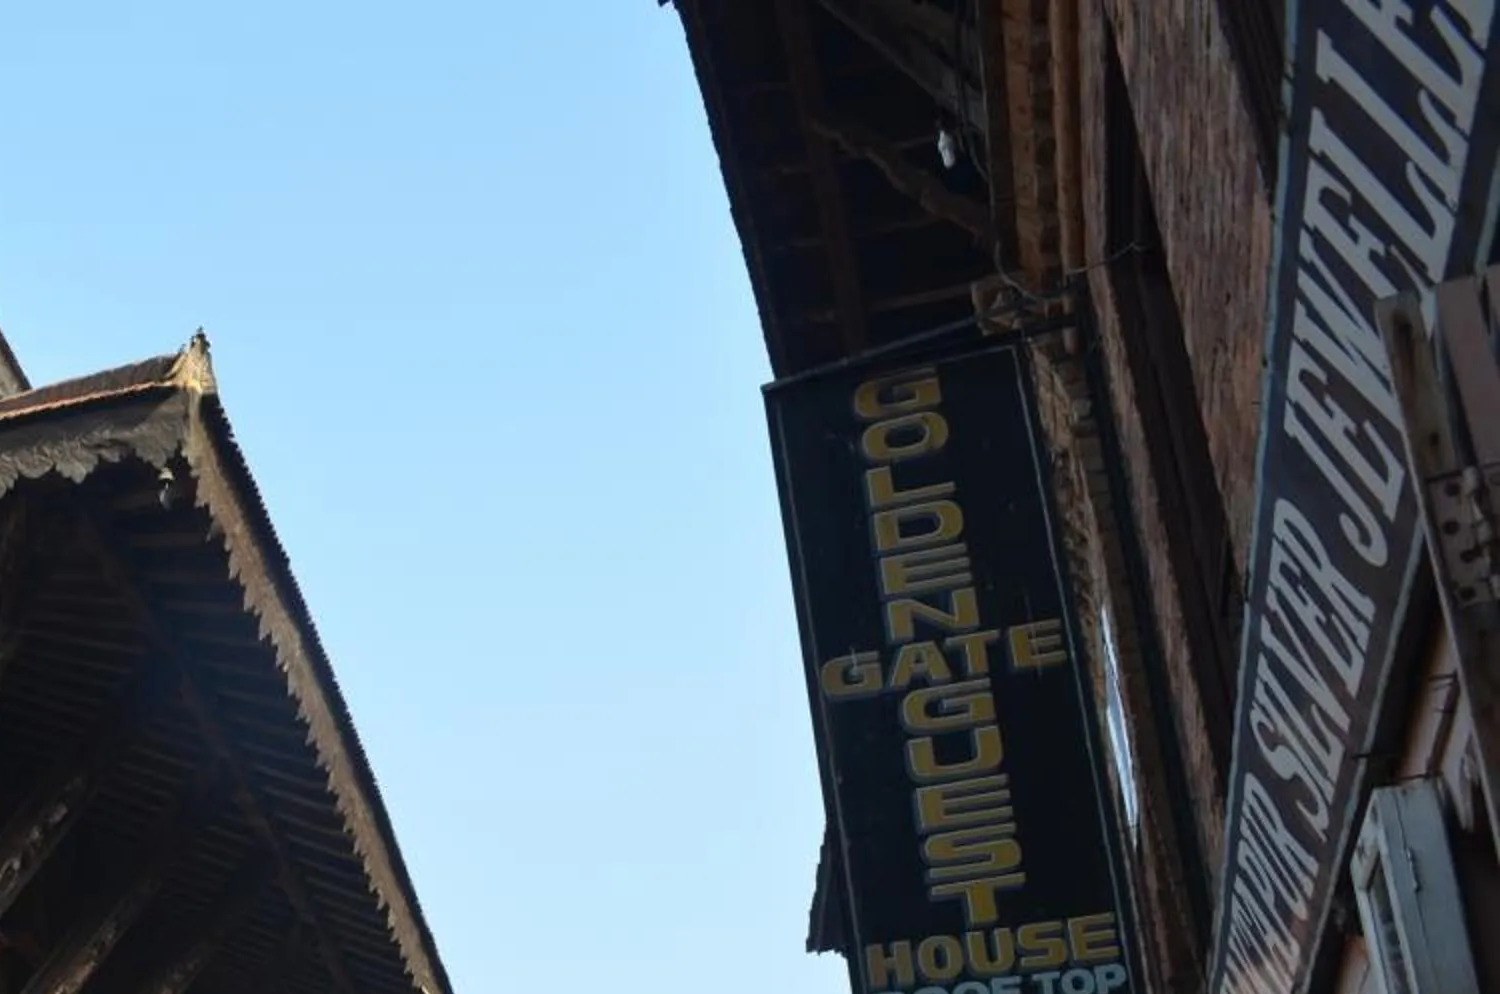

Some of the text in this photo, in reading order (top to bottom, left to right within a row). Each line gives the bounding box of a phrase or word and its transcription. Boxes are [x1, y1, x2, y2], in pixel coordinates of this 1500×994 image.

[1284, 0, 1497, 567] JEWELLE
[854, 367, 980, 641] GOLDEN
[821, 618, 1067, 698] GATE
[1249, 498, 1376, 843] SILVER
[902, 677, 1026, 925] GUEST
[866, 912, 1120, 987] HOUSE
